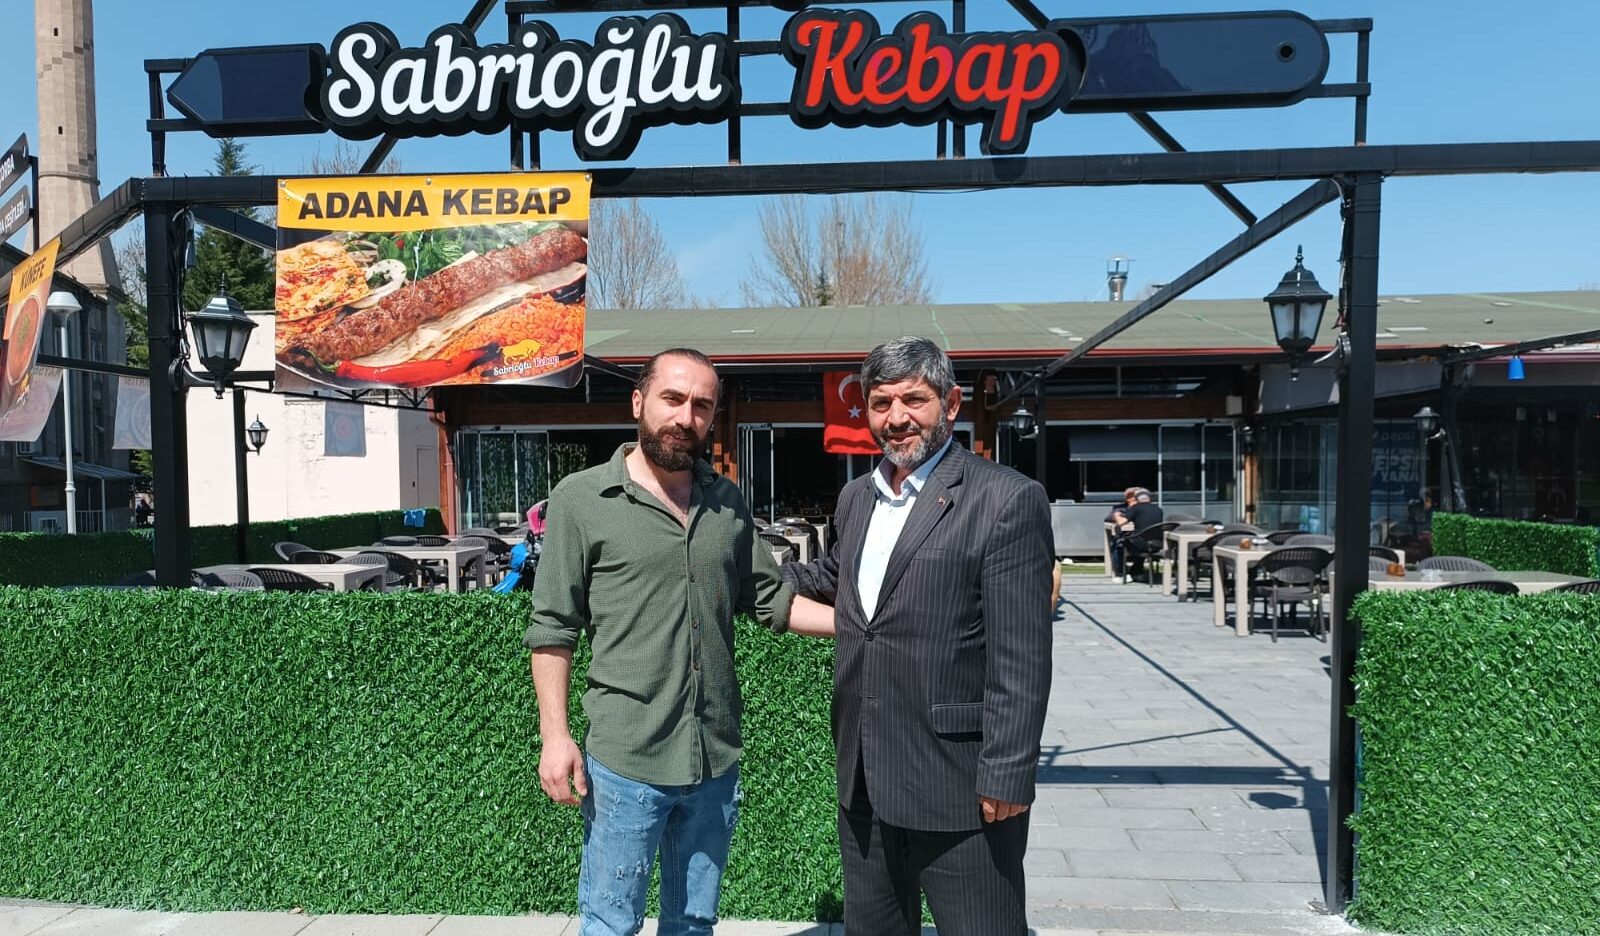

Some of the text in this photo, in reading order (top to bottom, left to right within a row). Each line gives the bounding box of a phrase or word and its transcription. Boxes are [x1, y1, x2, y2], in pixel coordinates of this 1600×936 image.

[328, 19, 1061, 148] Sabrioğlu Kebap
[0, 153, 15, 190] ORBA
[298, 187, 572, 220] ADANA KEBAP
[493, 356, 560, 375] Sabrioğlu Kebap
